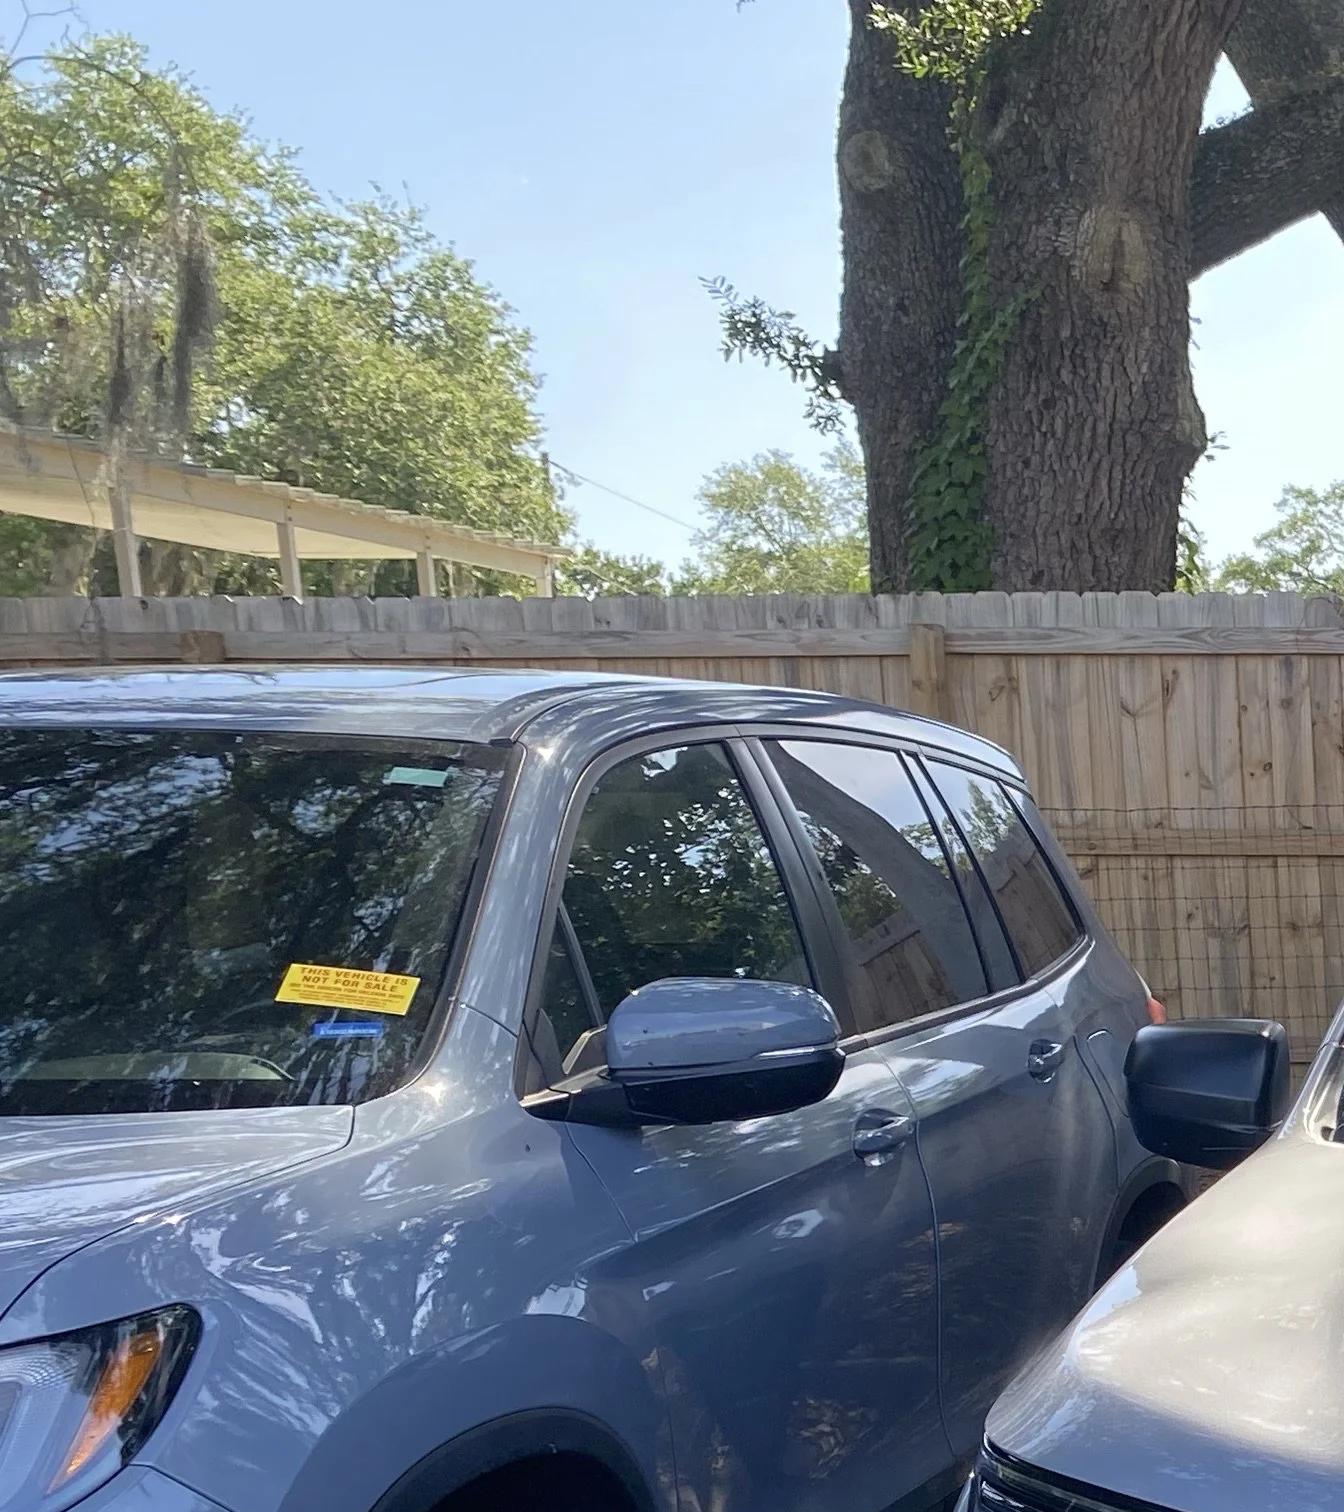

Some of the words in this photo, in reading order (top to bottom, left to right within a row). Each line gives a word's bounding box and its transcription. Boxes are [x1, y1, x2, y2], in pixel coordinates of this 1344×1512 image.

[301, 967, 330, 976] THIS
[335, 971, 393, 983] VEHICLE
[395, 977, 408, 986] IS
[302, 975, 329, 984] NOT
[334, 978, 360, 987] FOR
[364, 981, 398, 992] SALE
